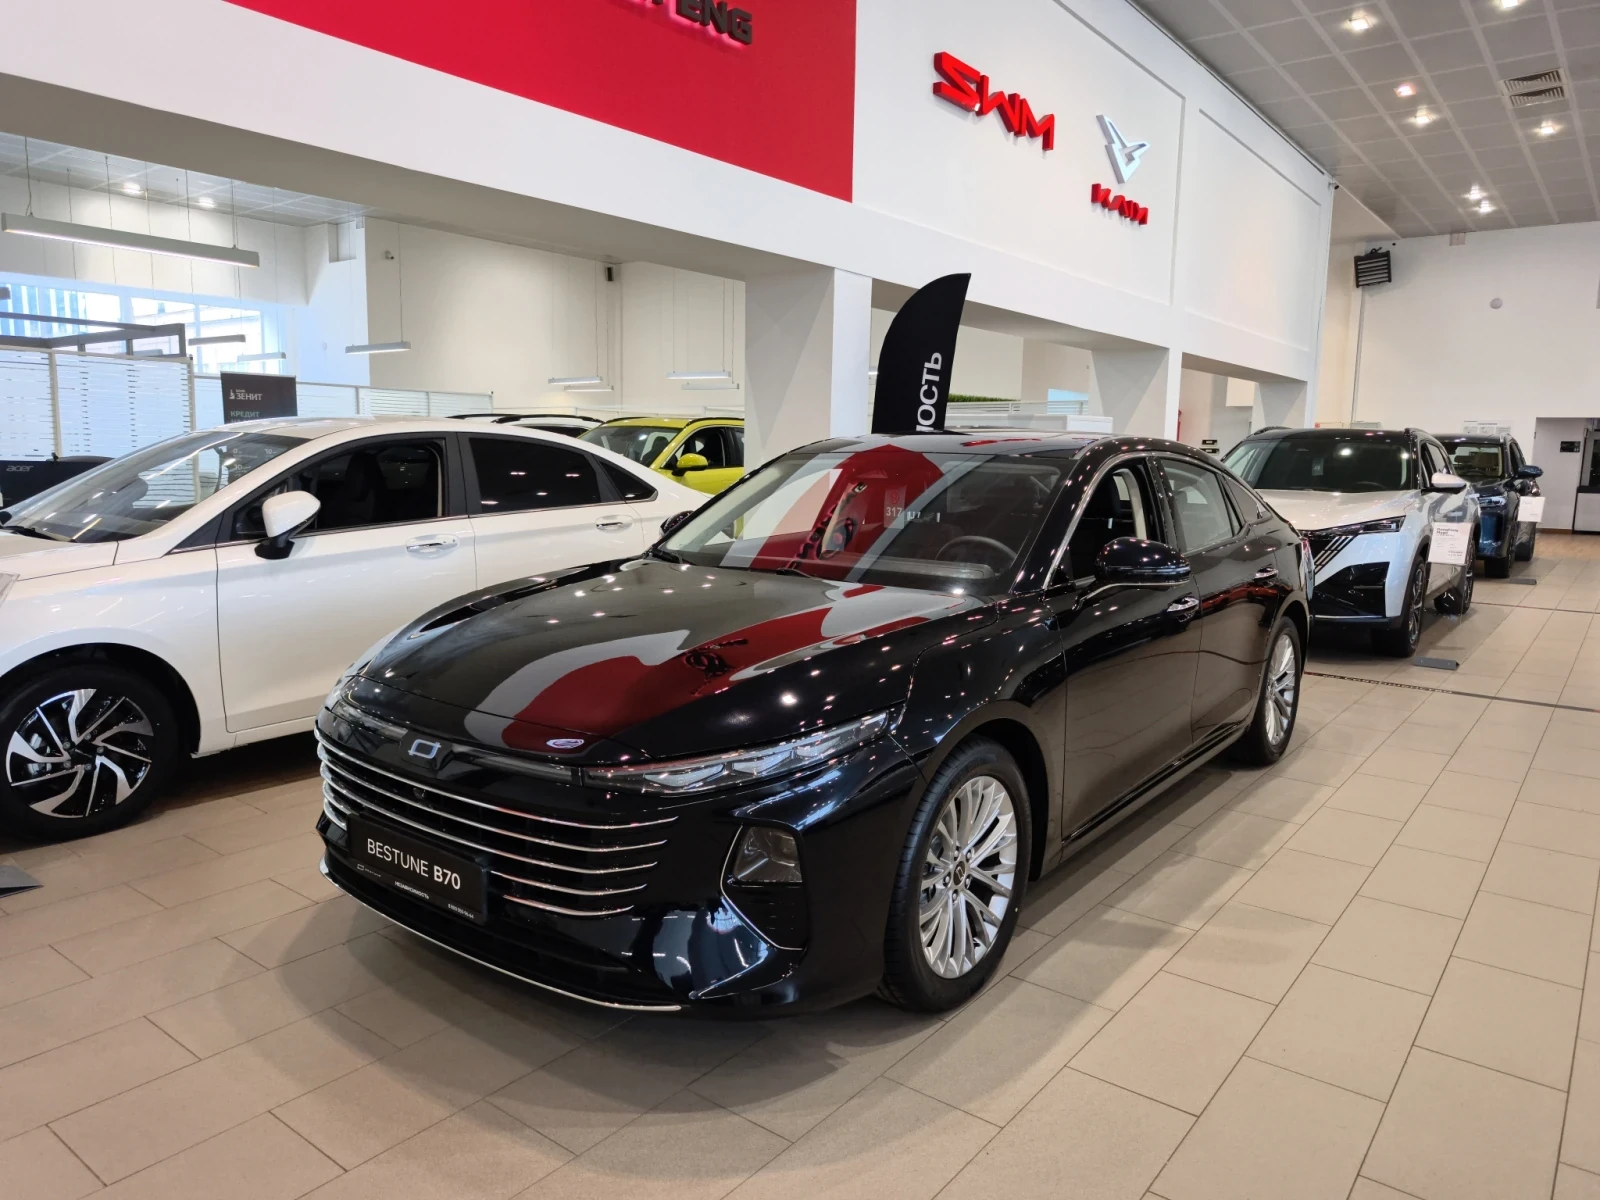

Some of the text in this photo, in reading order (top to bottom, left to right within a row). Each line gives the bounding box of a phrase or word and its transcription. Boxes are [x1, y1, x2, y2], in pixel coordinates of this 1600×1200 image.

[933, 51, 1055, 151] SWM
[236, 393, 263, 401] ЗЕНИТ
[230, 410, 260, 418] КРЕДИТ
[6, 464, 34, 472] acer
[885, 506, 903, 517] 317
[367, 838, 461, 890] BESTUNE B70
